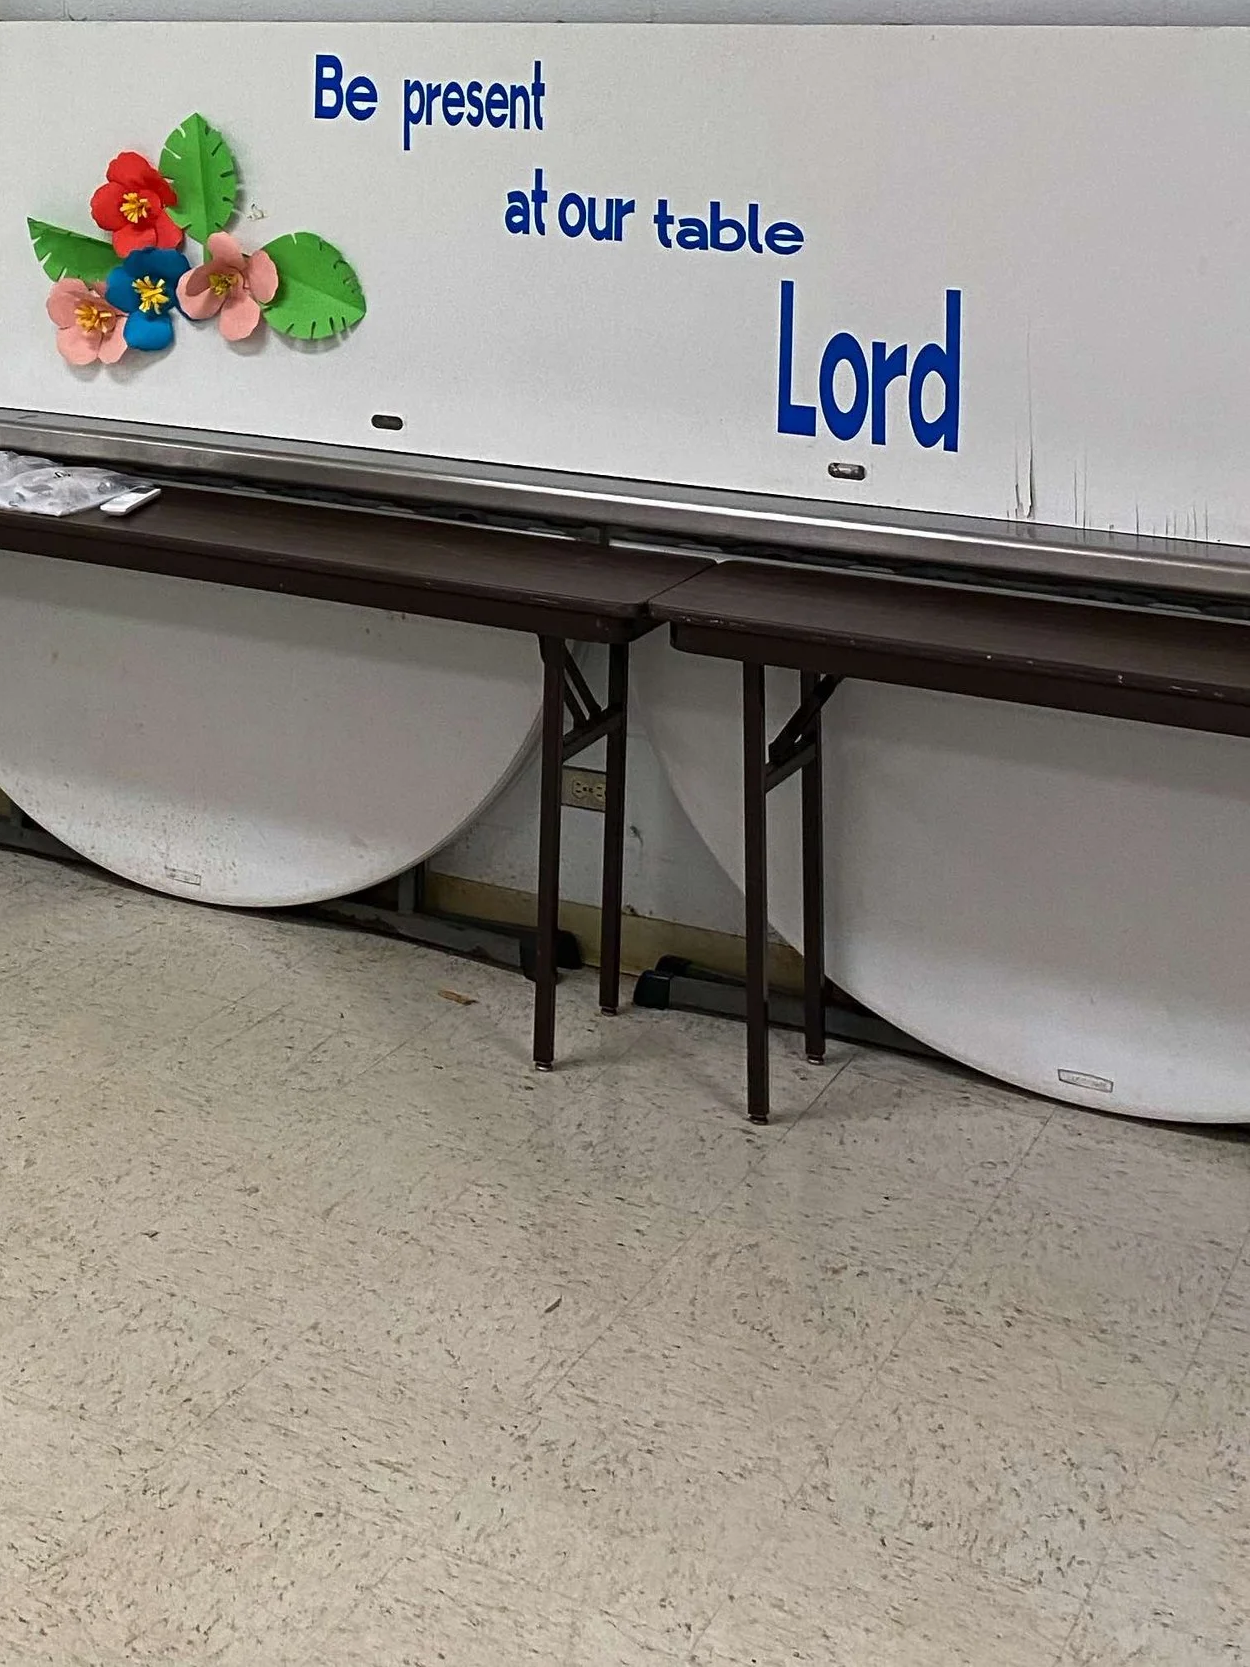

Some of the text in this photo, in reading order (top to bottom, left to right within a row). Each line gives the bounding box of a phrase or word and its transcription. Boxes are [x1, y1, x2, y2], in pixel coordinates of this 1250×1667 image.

[315, 54, 544, 150] Be present
[505, 167, 804, 254] at our table
[778, 280, 961, 452] Lord
